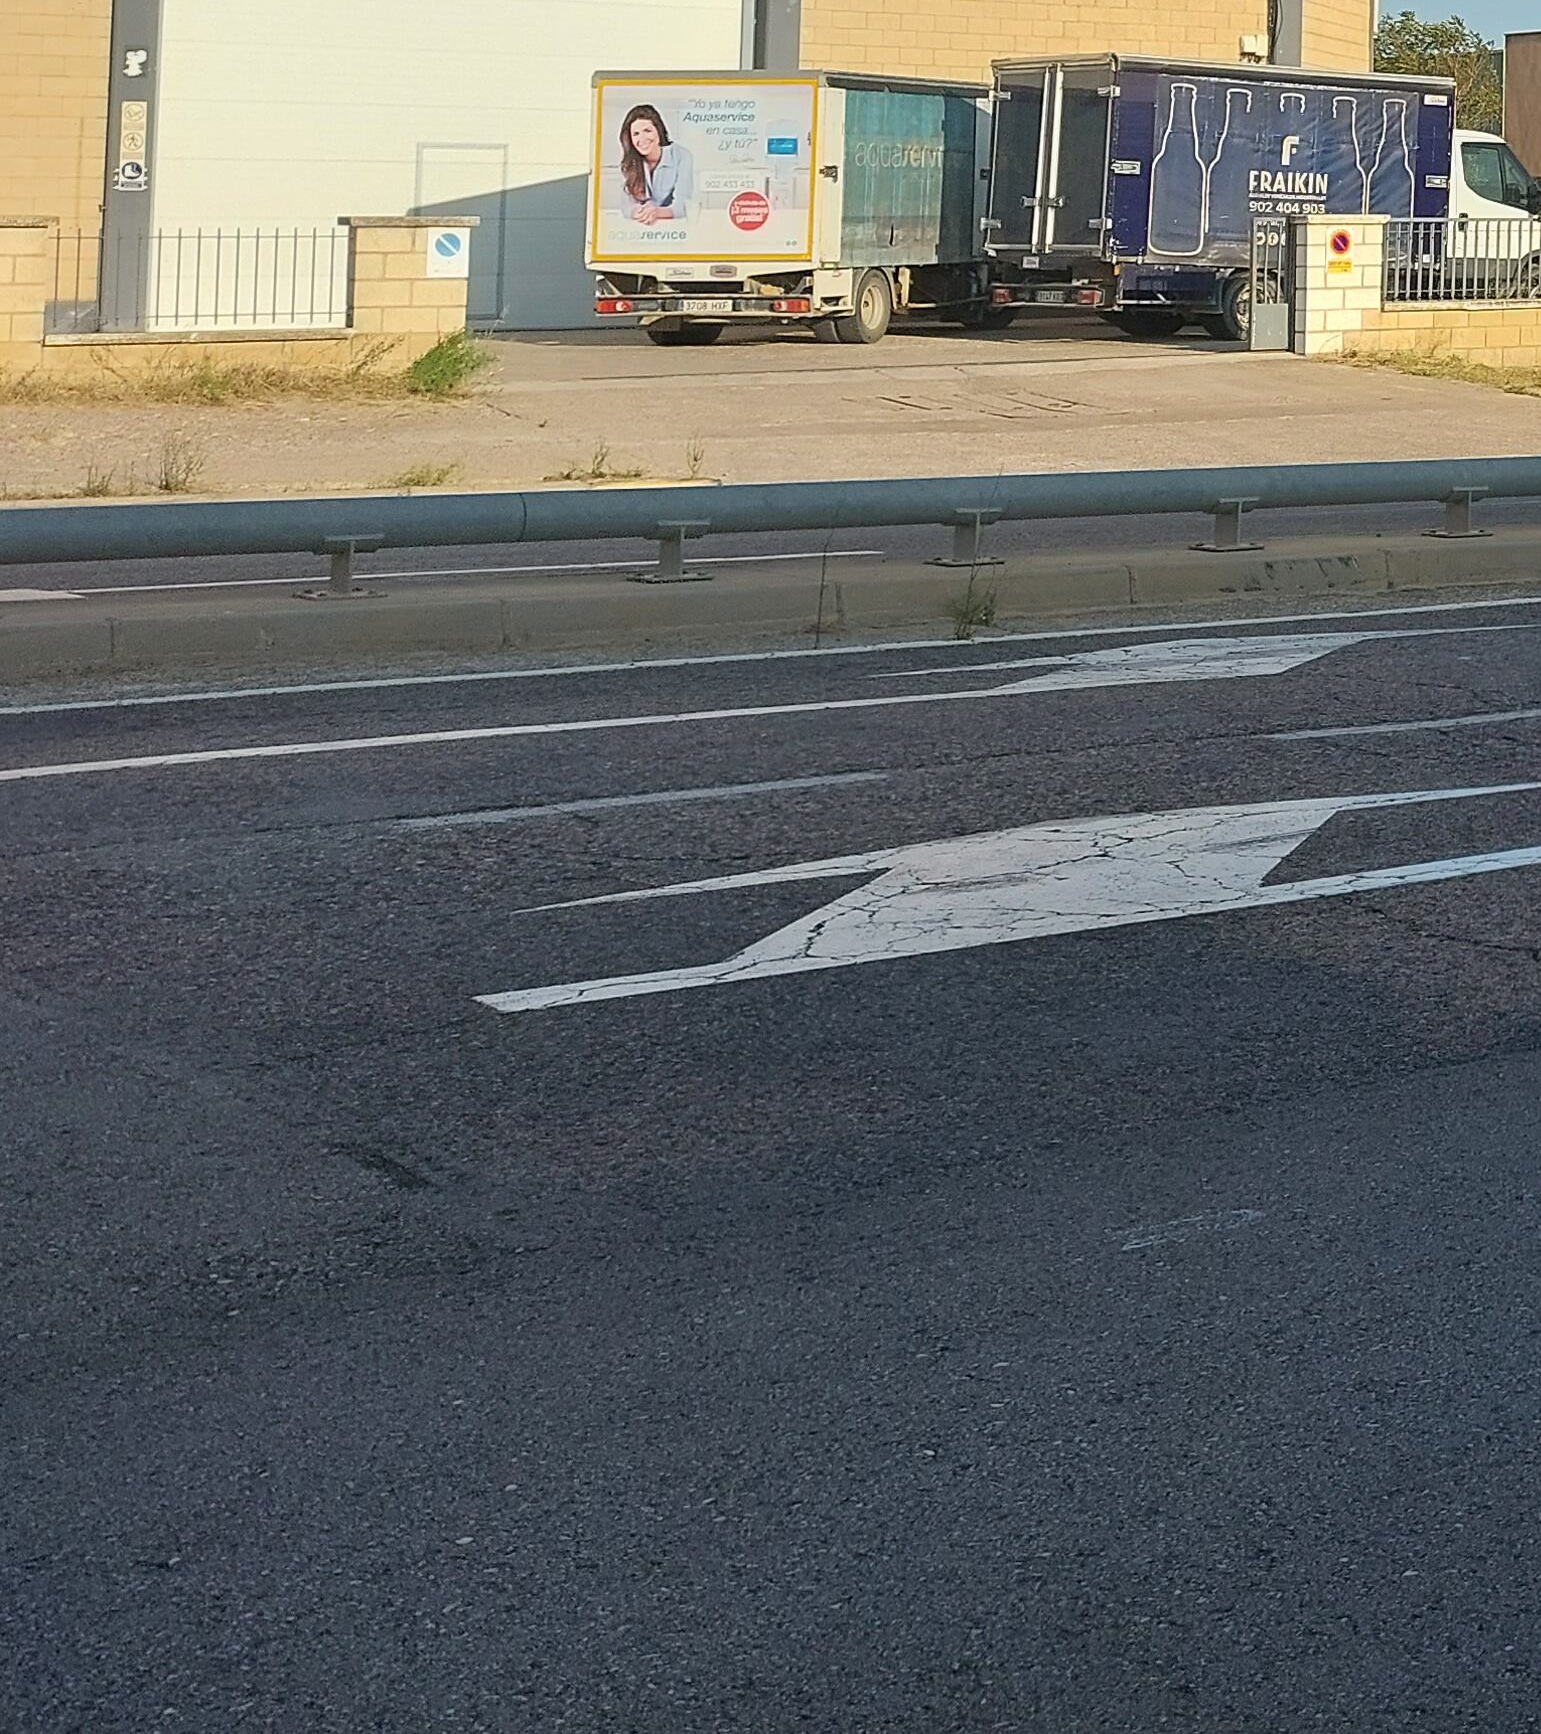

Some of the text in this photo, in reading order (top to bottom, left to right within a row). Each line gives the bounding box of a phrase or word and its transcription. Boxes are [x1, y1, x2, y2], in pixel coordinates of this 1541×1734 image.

[683, 112, 755, 123] Aquaservice
[1248, 170, 1328, 194] FRAIKIN
[1248, 201, 1326, 214] 902 404 903
